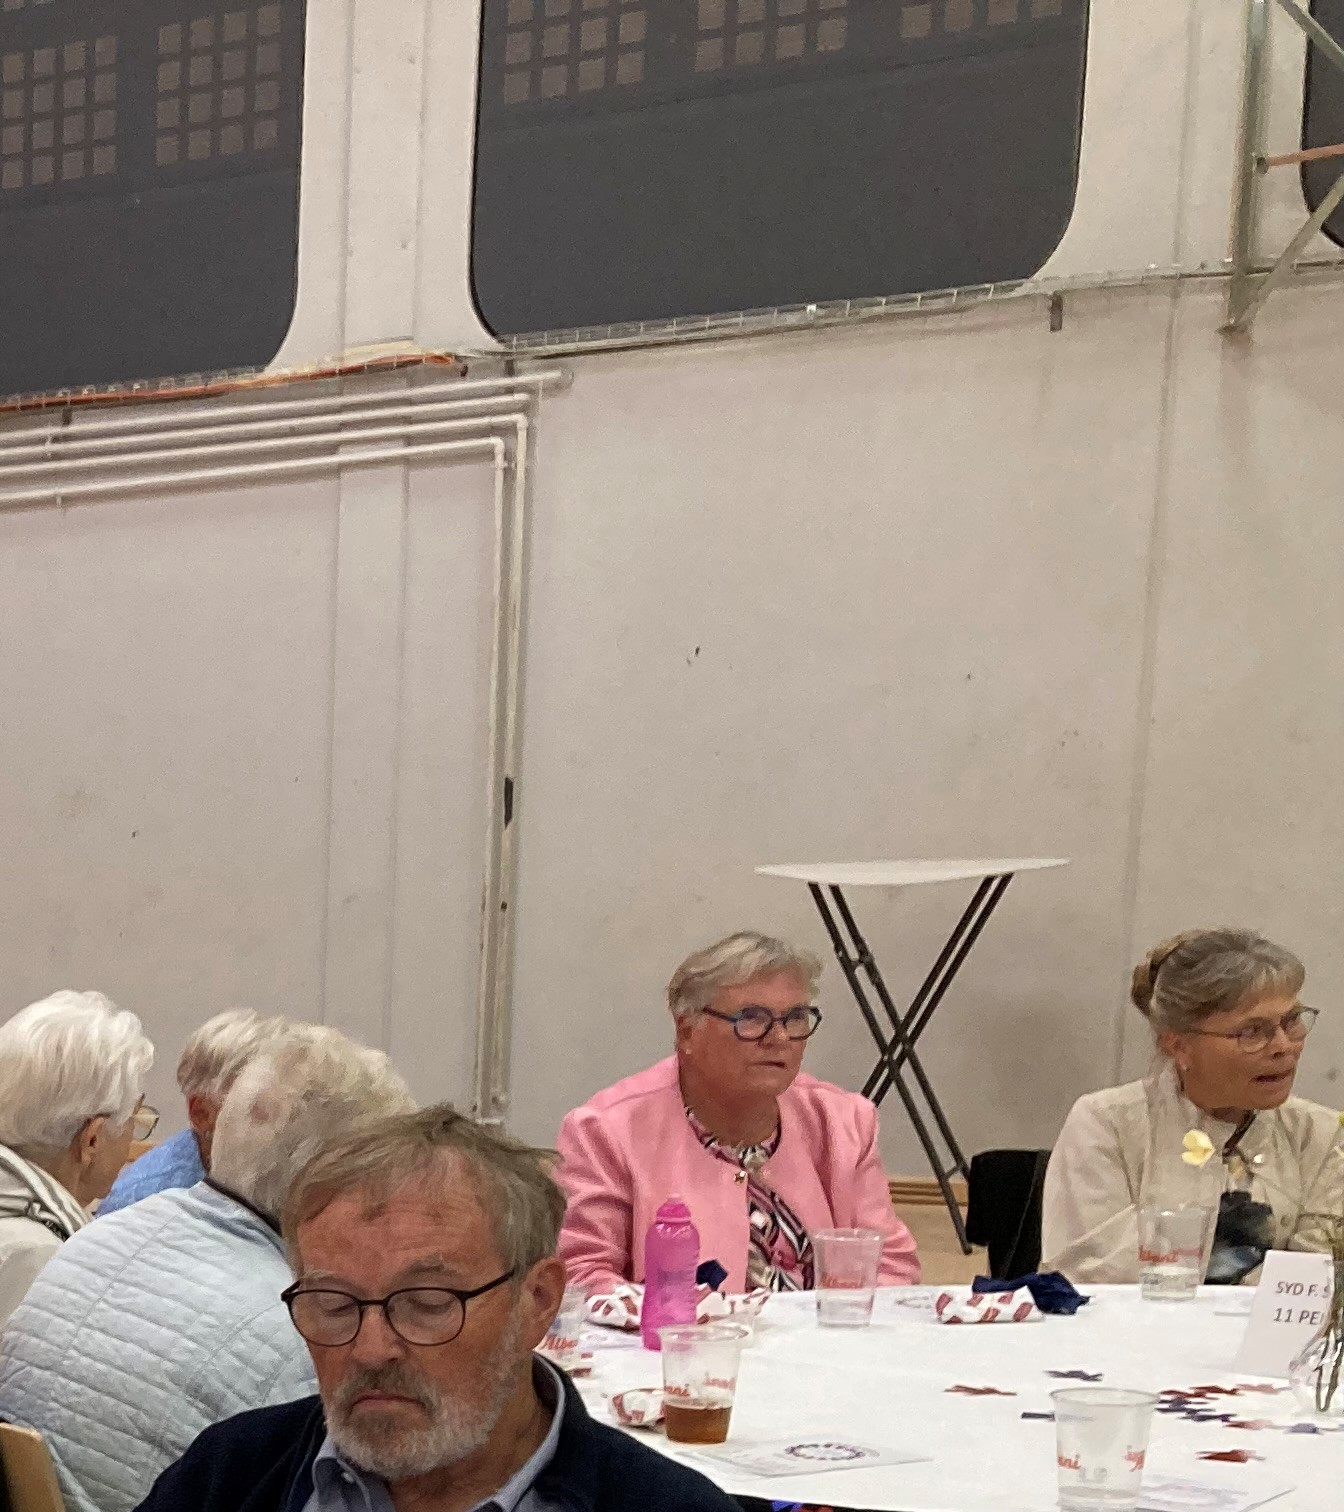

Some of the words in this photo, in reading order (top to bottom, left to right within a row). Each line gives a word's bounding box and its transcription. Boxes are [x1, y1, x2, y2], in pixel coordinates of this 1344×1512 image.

[1275, 1281, 1304, 1296] SYD
[1273, 1307, 1293, 1323] 11
[1298, 1309, 1324, 1326] PE
